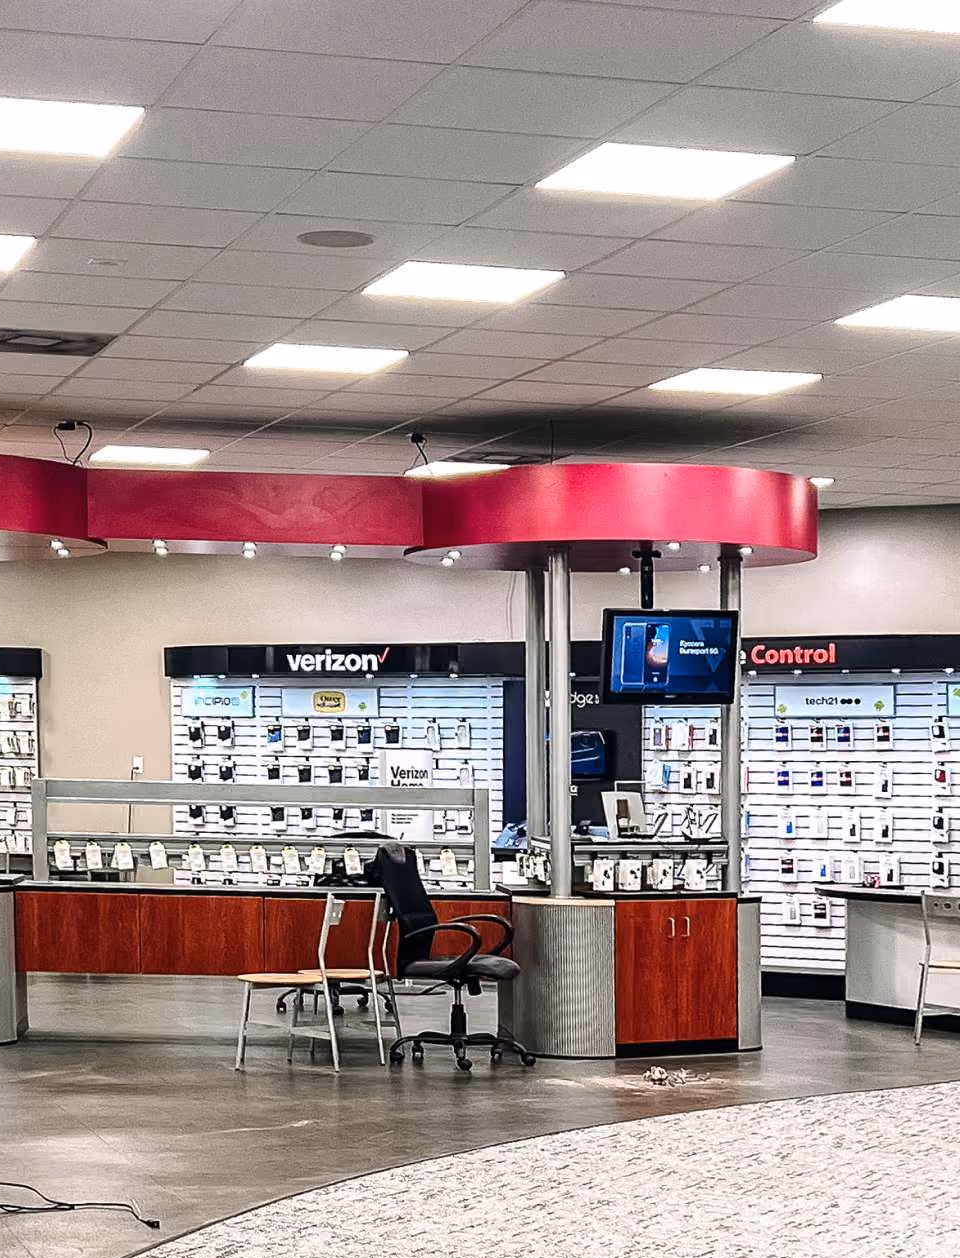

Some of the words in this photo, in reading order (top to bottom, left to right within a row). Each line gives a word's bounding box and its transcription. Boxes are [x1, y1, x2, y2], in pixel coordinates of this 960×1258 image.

[679, 639, 705, 648] Kyocera
[286, 648, 379, 672] verizon
[751, 642, 836, 665] Control
[805, 696, 839, 706] tech21
[390, 765, 429, 780] Verizon
